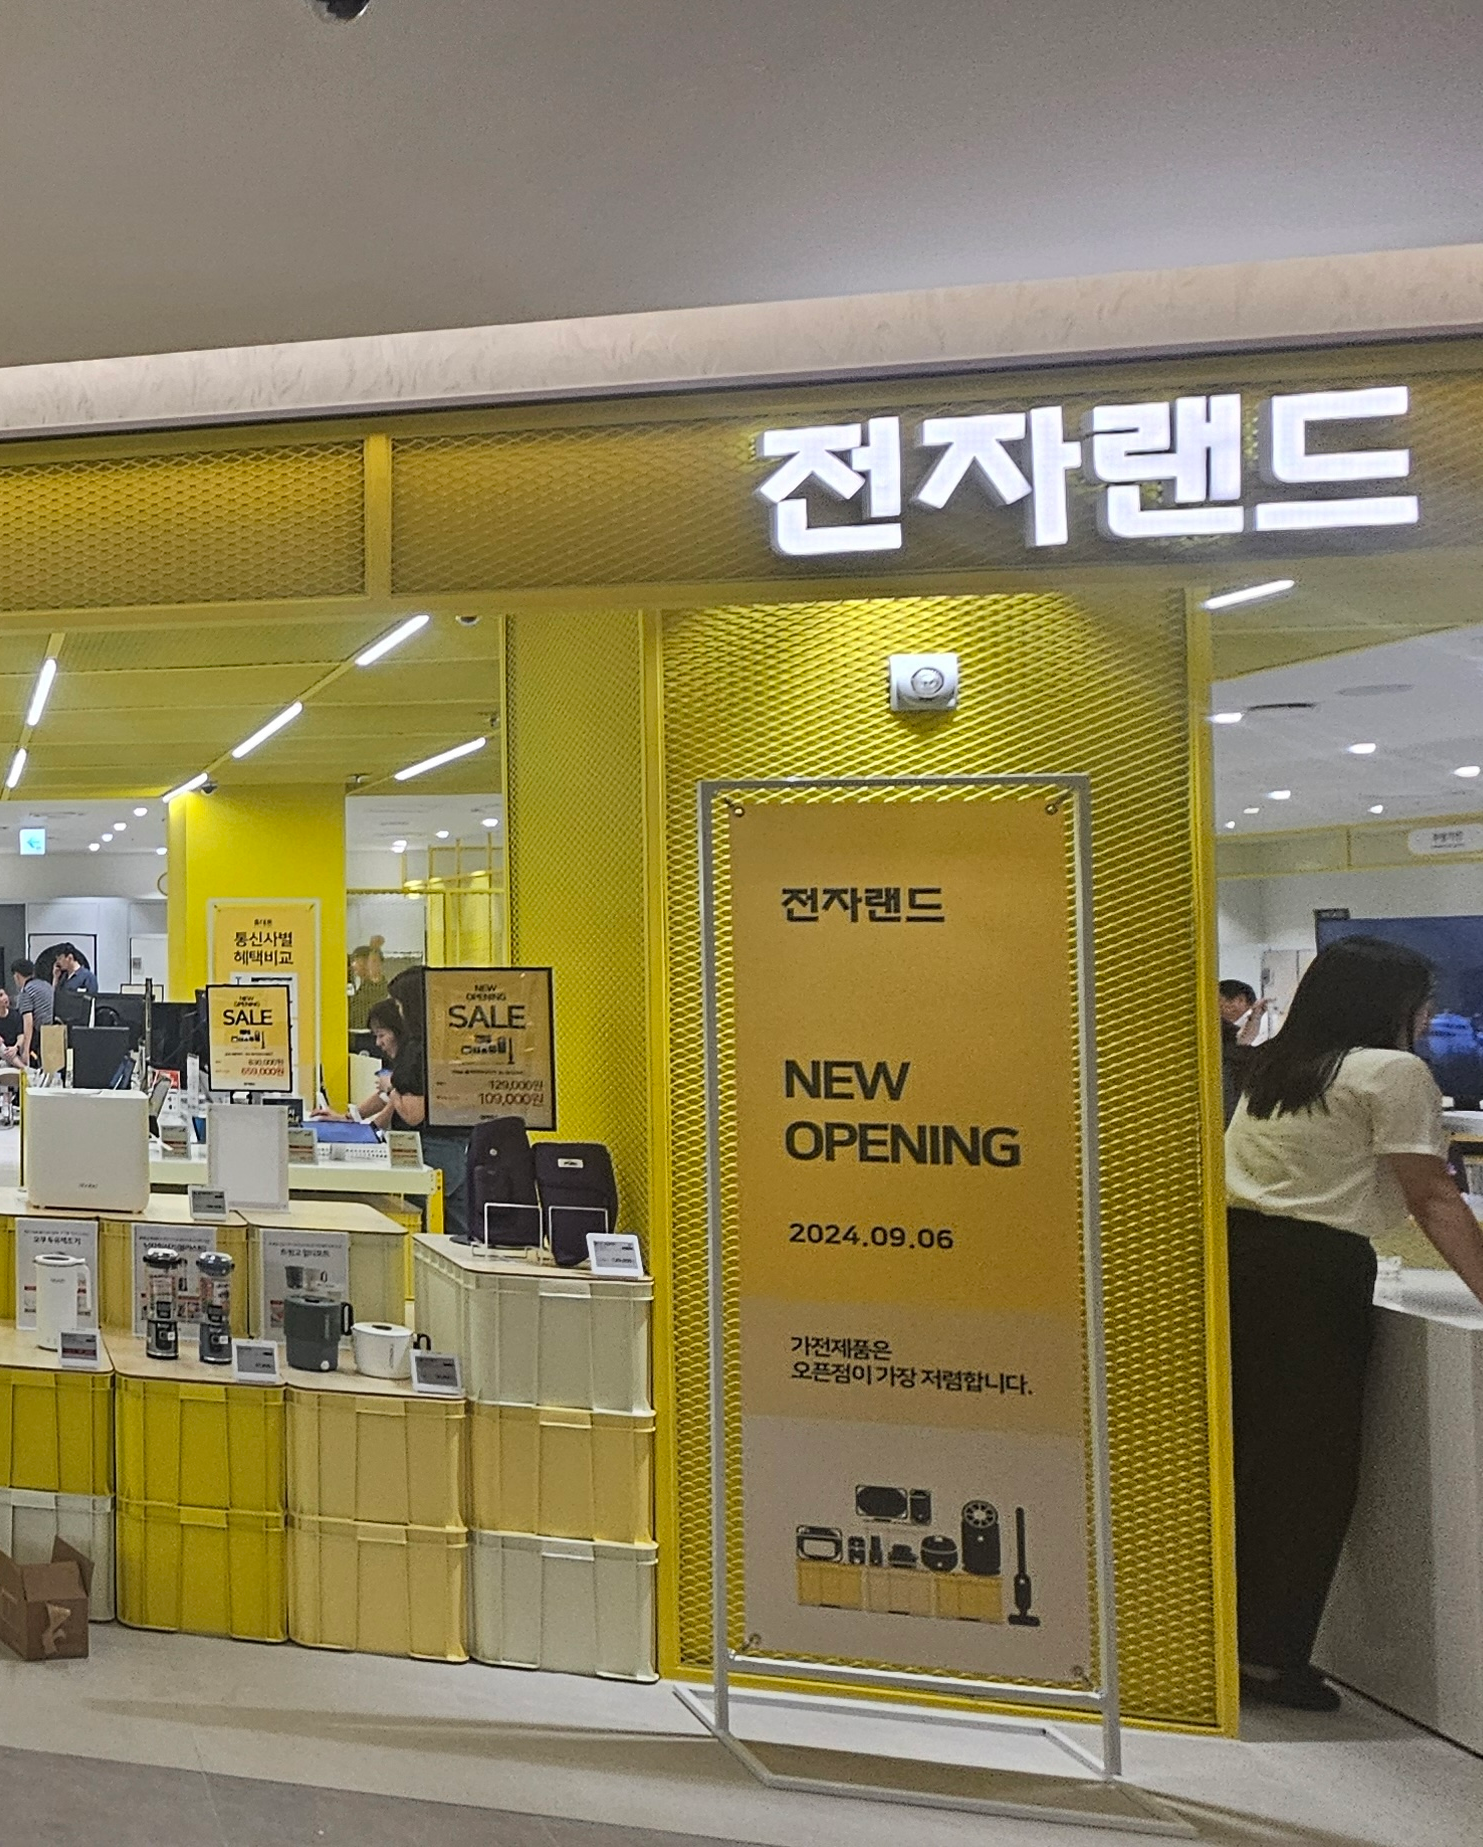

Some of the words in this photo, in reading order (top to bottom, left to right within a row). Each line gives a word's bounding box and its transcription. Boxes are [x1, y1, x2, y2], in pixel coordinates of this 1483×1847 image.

[756, 385, 1420, 557] 전자랜드
[781, 887, 945, 923] 전자랜드
[234, 931, 293, 948] 통신사별
[466, 992, 506, 1001] OPENING
[475, 984, 497, 992] NEW
[222, 1009, 273, 1027] SALE
[448, 1004, 526, 1029] SALE
[784, 1059, 911, 1101] NEW
[479, 1093, 544, 1107] 109,000원
[784, 1119, 1021, 1168] OPENING
[788, 1222, 955, 1250] 2024.09.06
[790, 1335, 892, 1361] 가전제품은
[791, 1361, 872, 1386] 오픈점이
[876, 1366, 917, 1388] 가장
[920, 1369, 1033, 1396] 저렴합니다.
